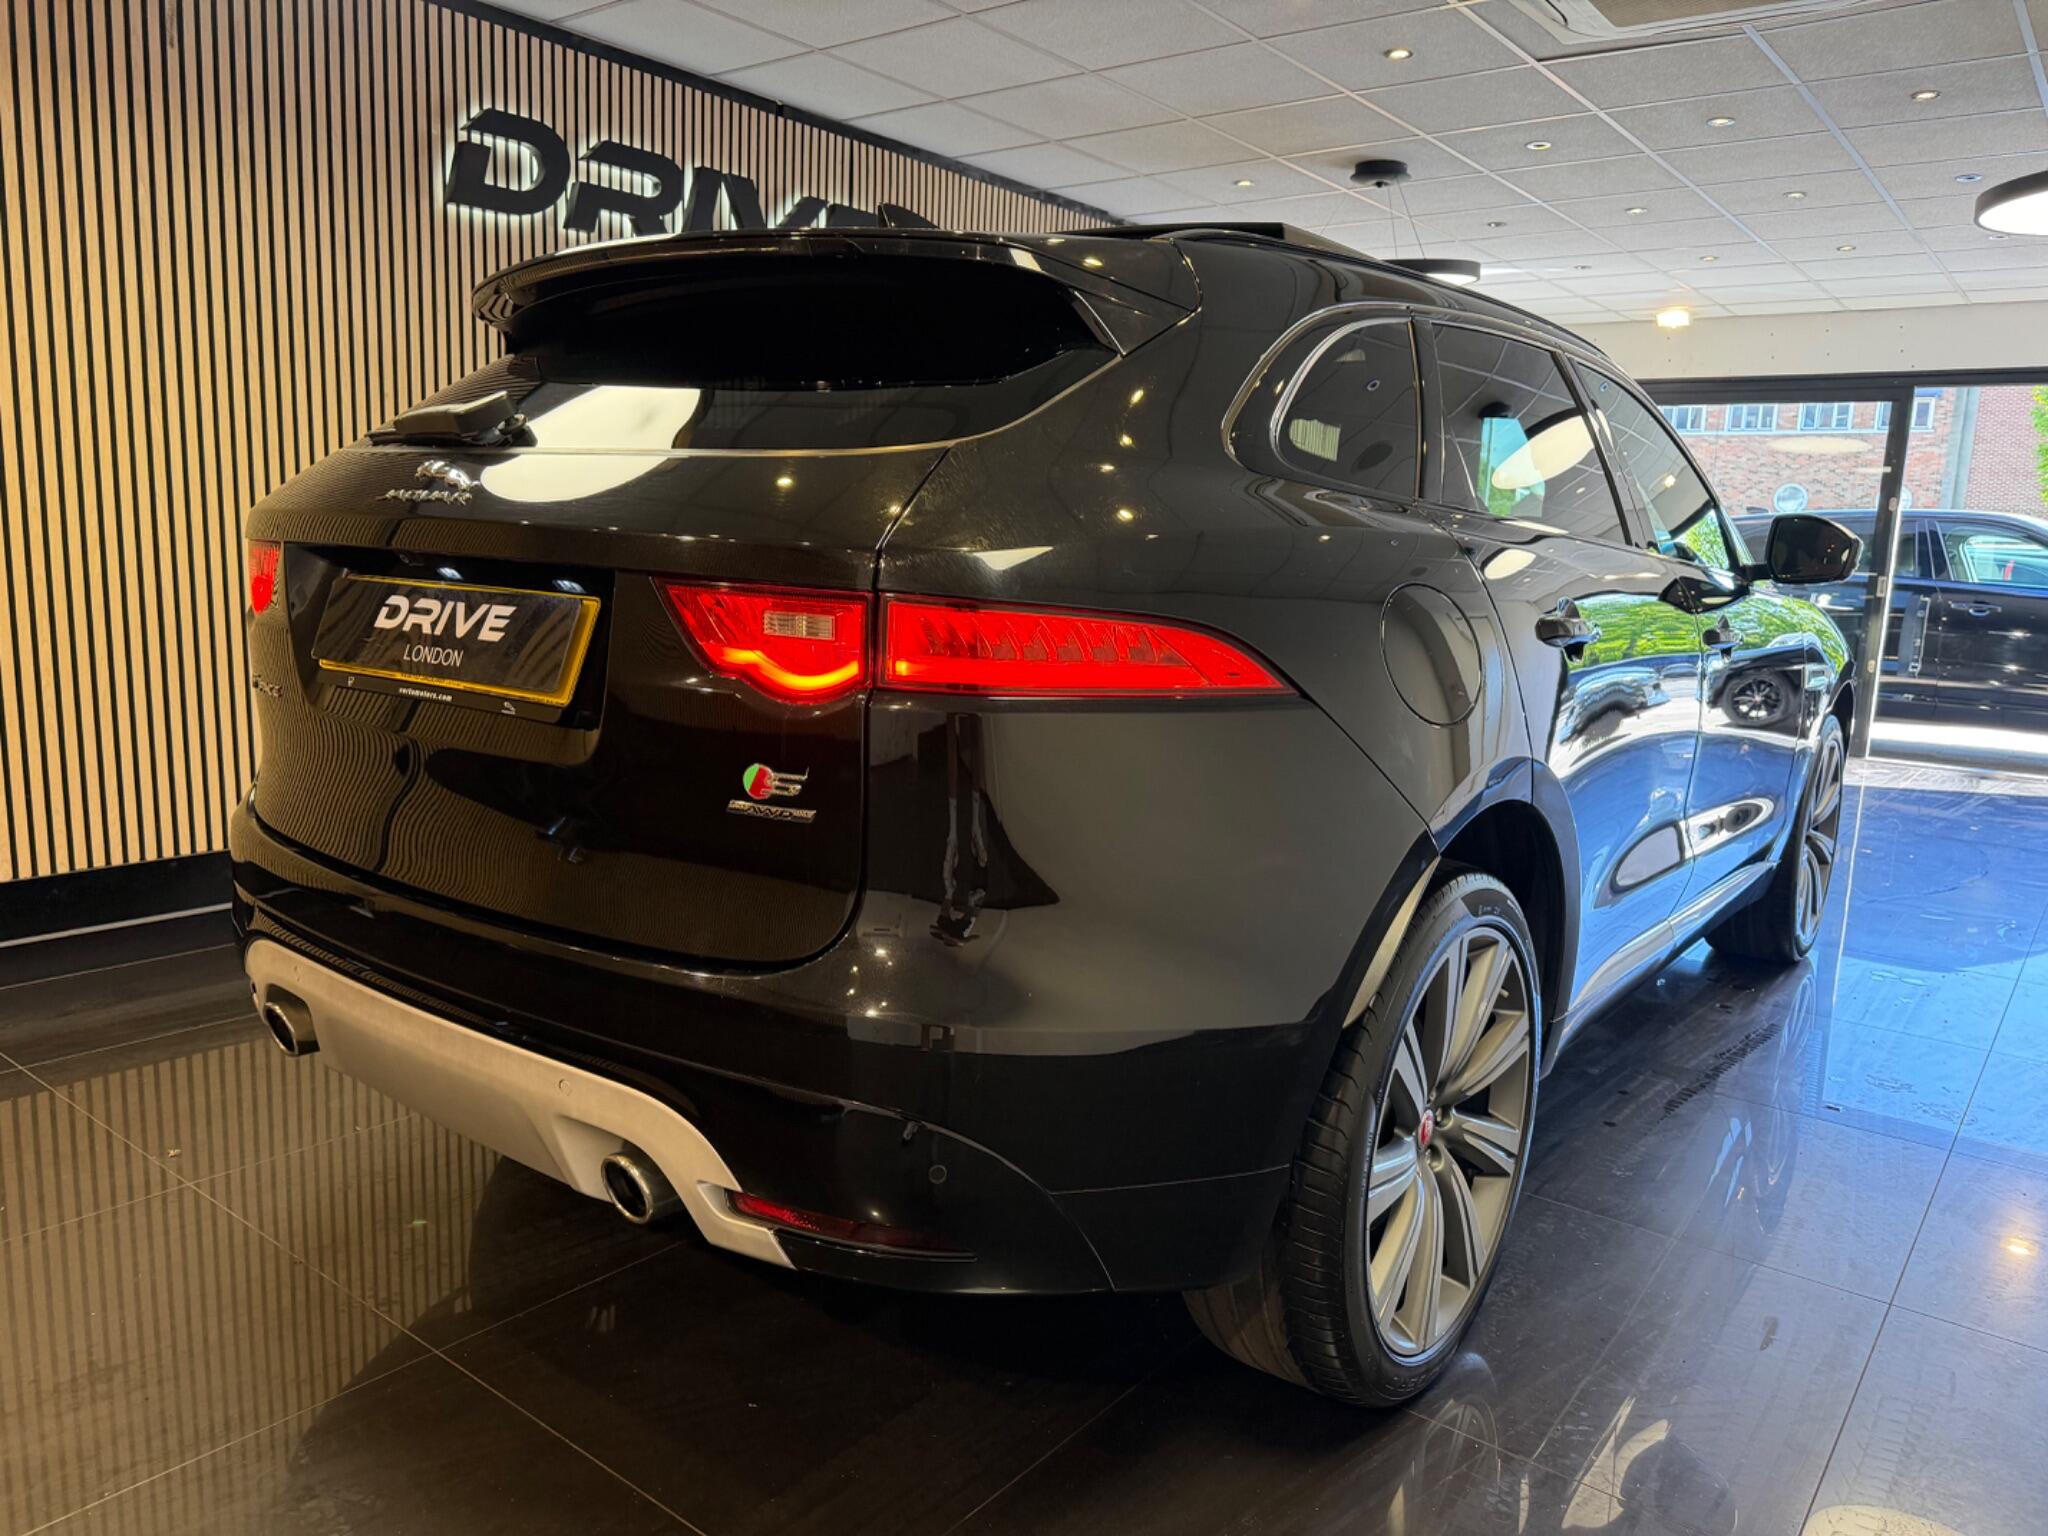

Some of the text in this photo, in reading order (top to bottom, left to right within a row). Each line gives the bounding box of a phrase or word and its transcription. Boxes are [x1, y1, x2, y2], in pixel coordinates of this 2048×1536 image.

[446, 108, 880, 231] DRIV
[374, 595, 517, 642] DRIVE
[403, 644, 463, 668] LONDON
